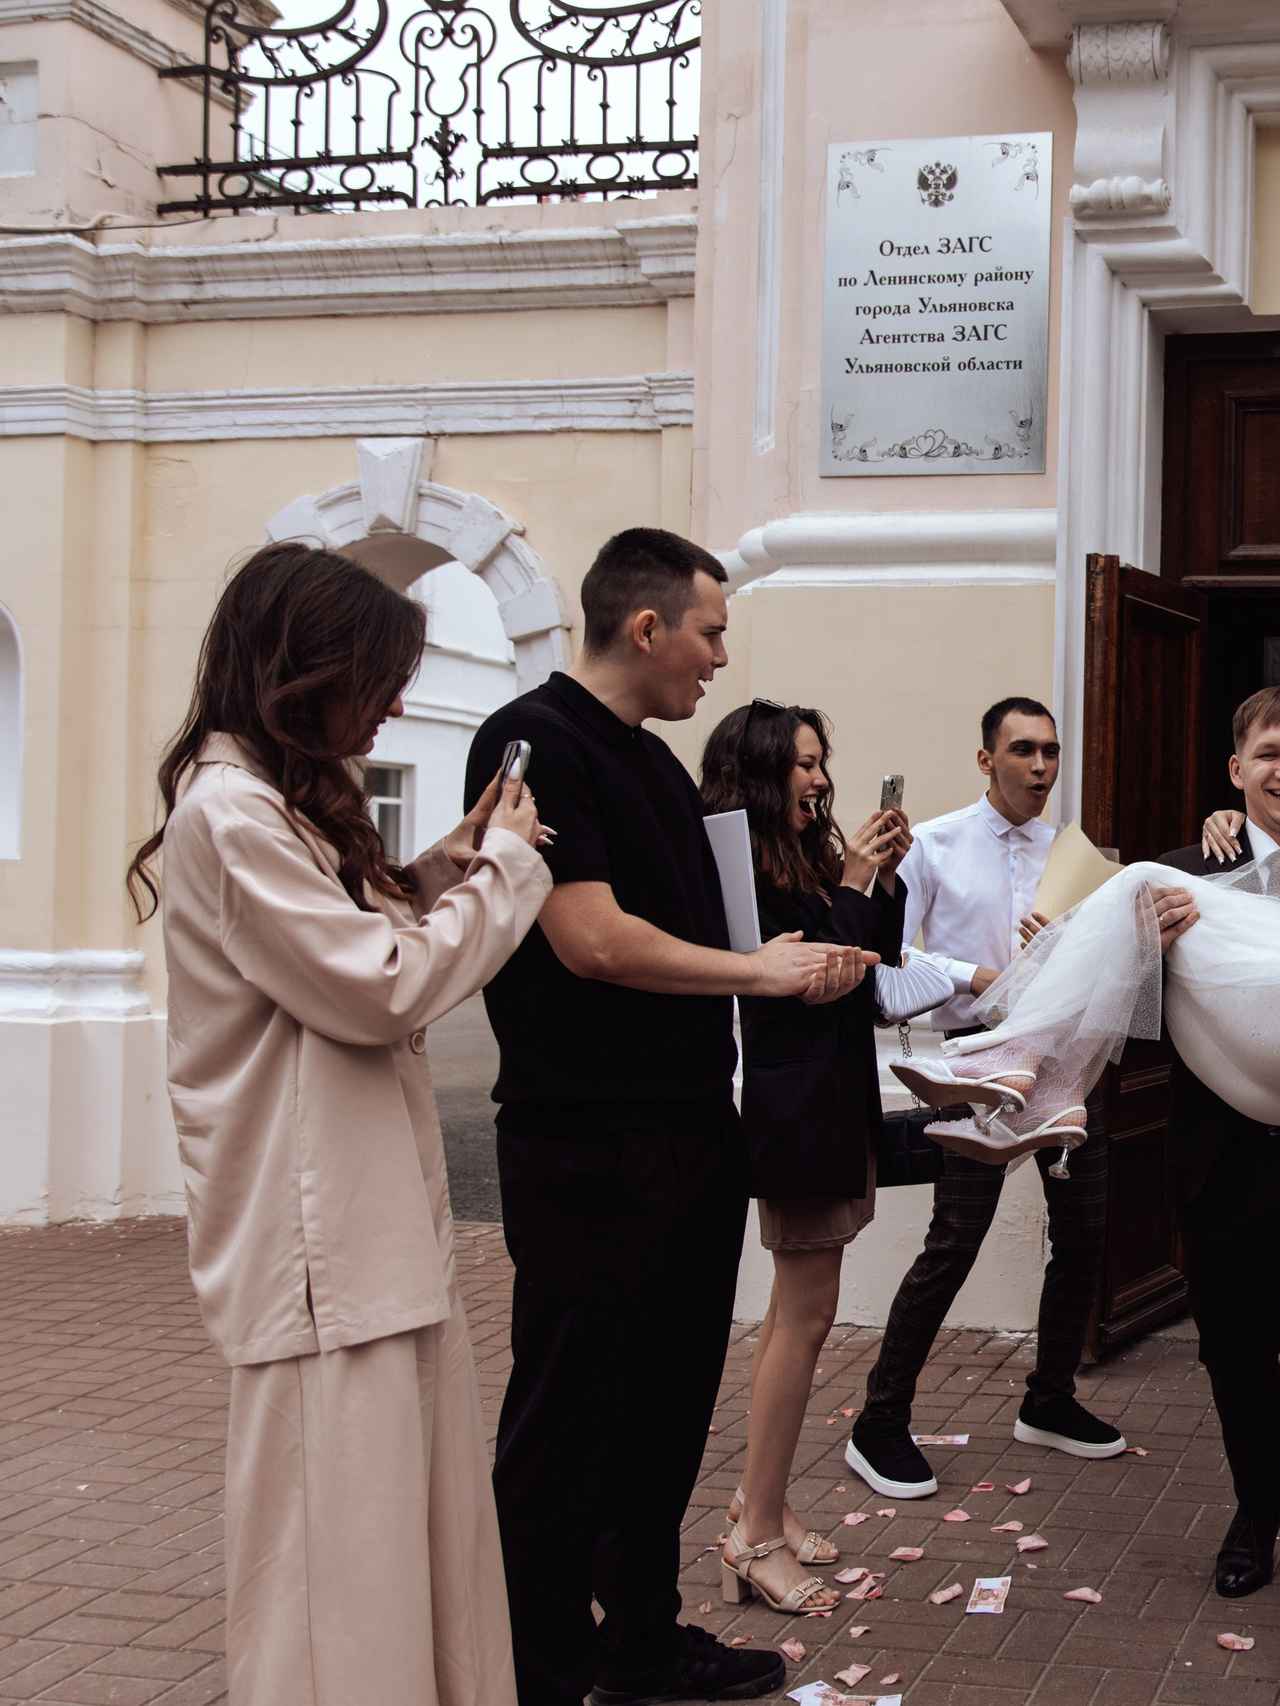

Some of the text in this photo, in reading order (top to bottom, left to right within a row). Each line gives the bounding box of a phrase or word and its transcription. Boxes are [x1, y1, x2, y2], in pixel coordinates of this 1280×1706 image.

[879, 235, 993, 258] Отдел ЗАГС
[838, 266, 1034, 287] по Ленинскому району
[855, 296, 1016, 320] города Ульяновска
[859, 323, 1008, 345] Агентства ЗАГС
[844, 356, 1023, 375] Ульяновской области
